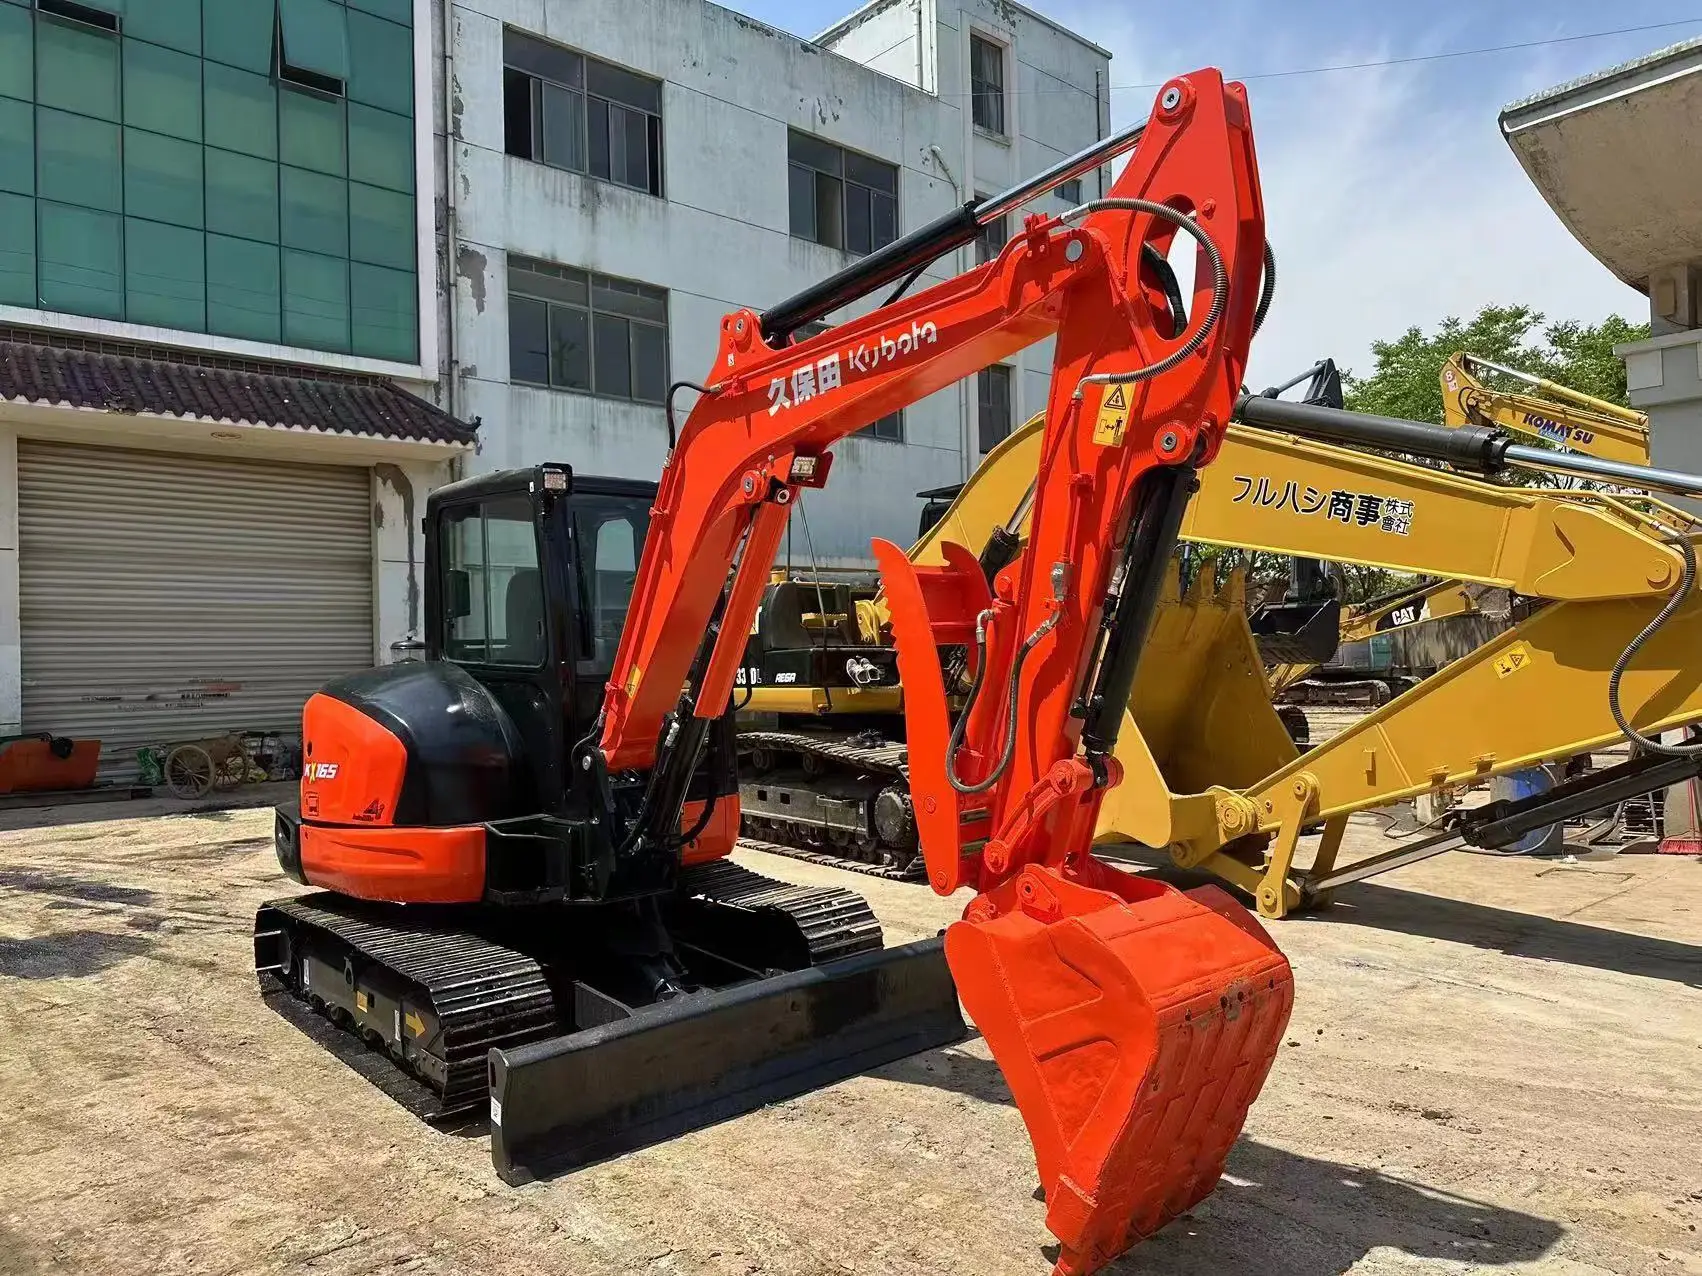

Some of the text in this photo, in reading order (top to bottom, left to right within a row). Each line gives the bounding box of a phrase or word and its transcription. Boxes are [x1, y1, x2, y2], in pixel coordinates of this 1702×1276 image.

[767, 320, 938, 417] 久保田 Kubota
[1522, 412, 1595, 445] KOMATSU
[1232, 475, 1384, 527] フルハシ商事
[1384, 497, 1415, 519] 株式
[1391, 605, 1415, 626] CAT
[304, 761, 339, 784] KX165
